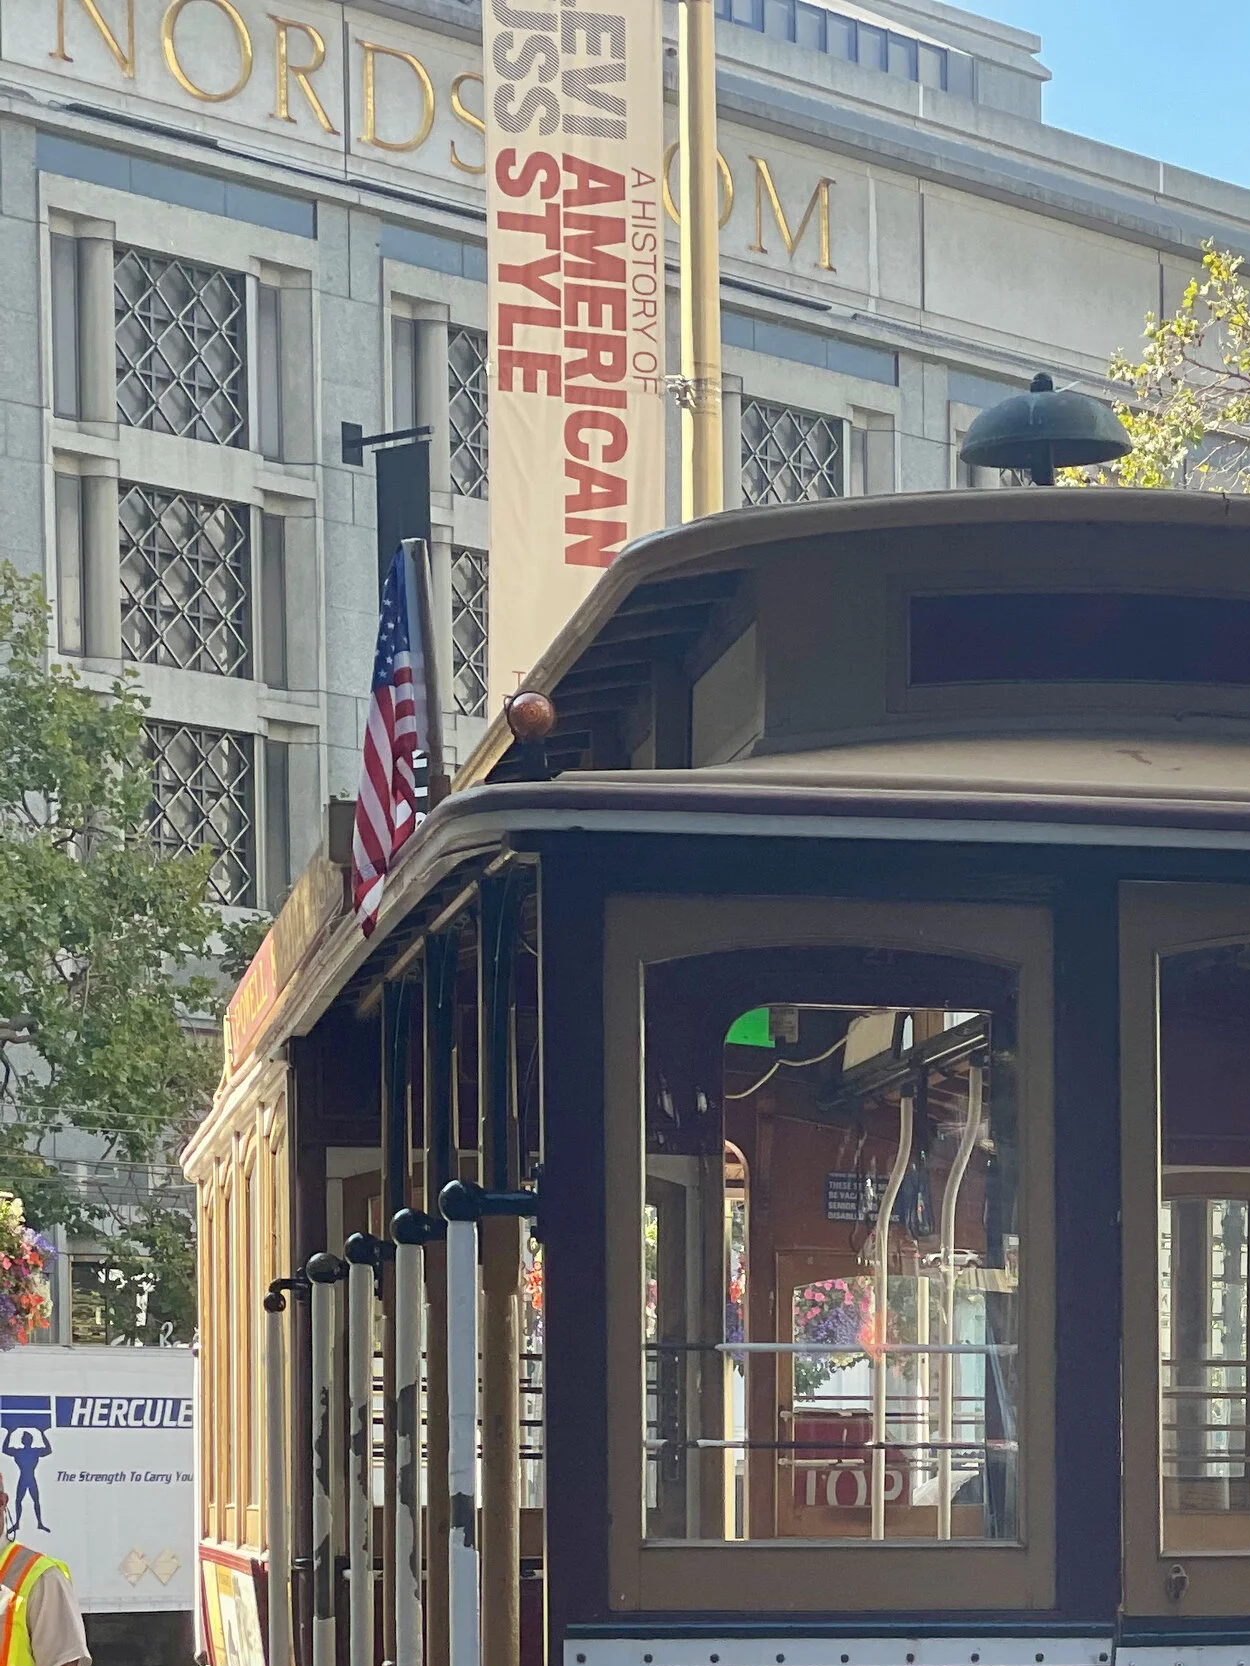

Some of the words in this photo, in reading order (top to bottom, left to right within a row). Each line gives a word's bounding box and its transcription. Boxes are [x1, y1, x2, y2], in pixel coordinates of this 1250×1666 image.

[630, 166, 657, 189] A
[494, 147, 562, 397] STYLE
[630, 200, 659, 344] HISTORY
[561, 152, 629, 569] AMERICAN
[631, 351, 659, 394] OF
[57, 1471, 76, 1482] The
[79, 1471, 126, 1485] Strength
[130, 1471, 142, 1482] To
[144, 1471, 172, 1485] Carry
